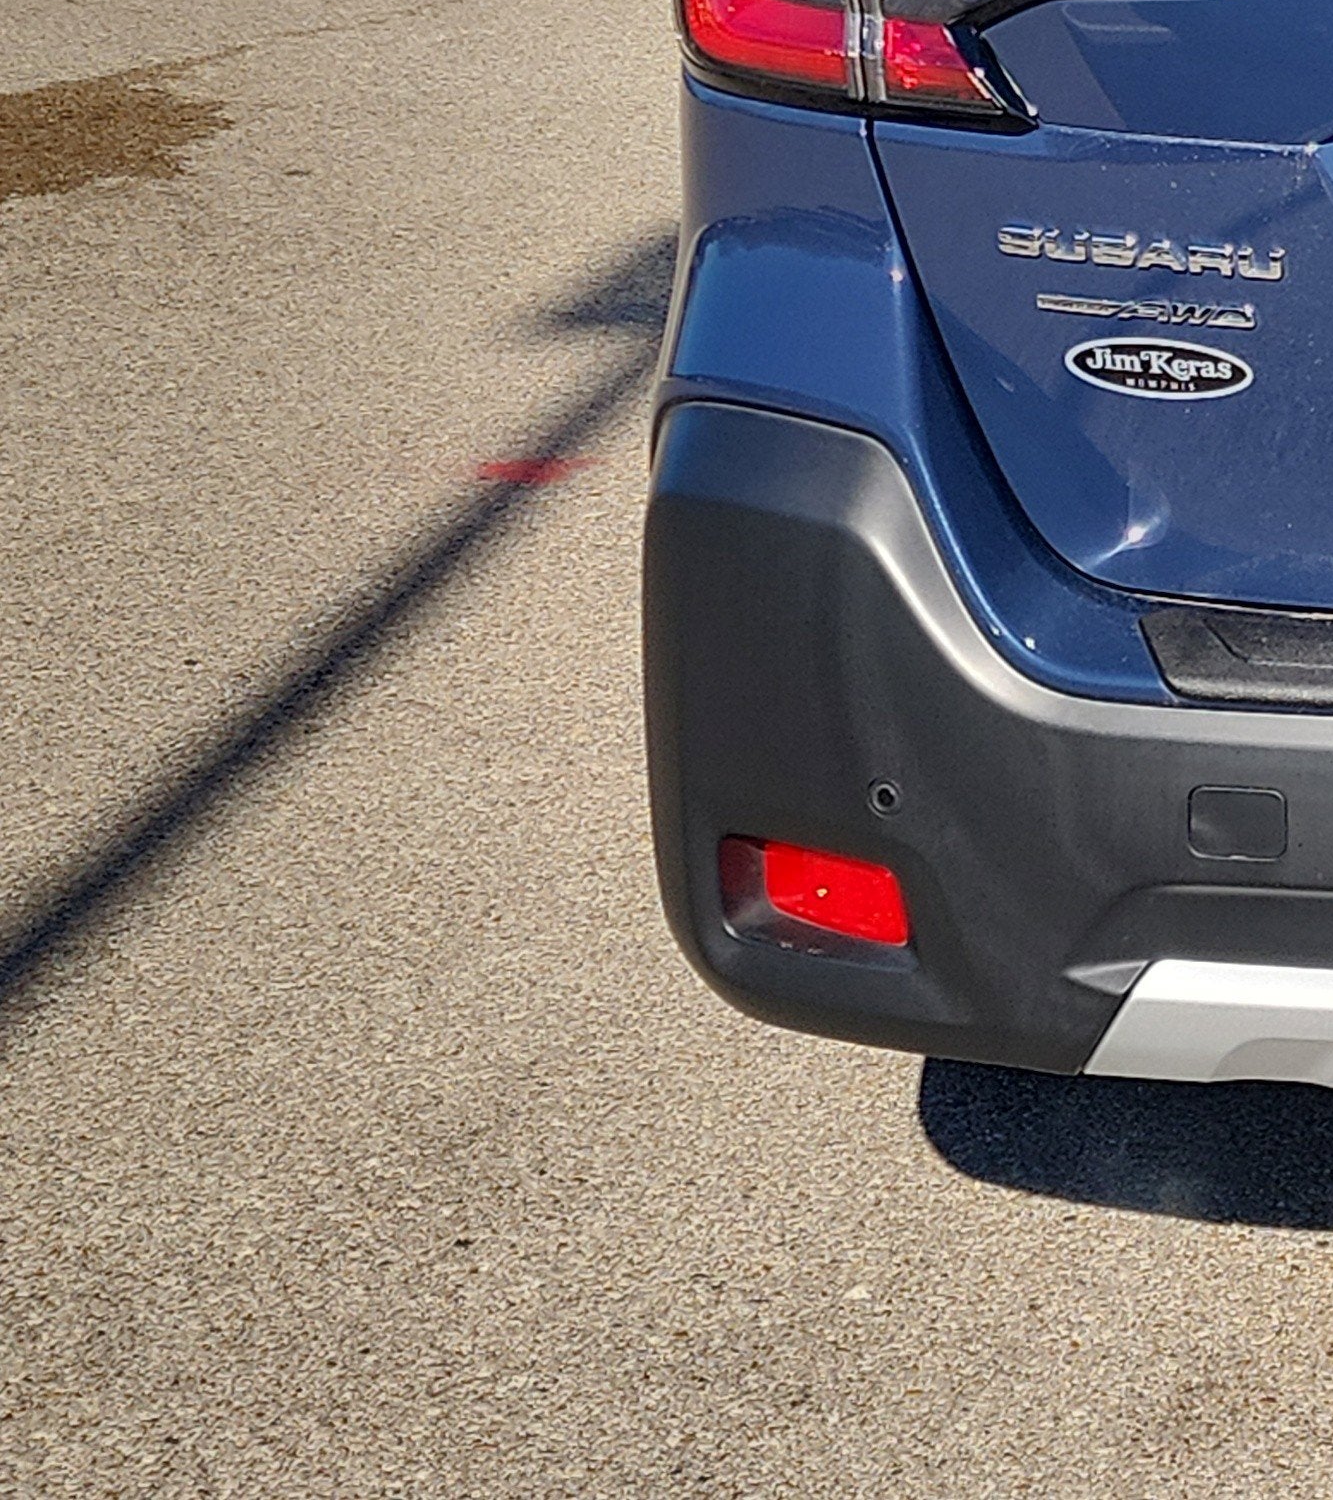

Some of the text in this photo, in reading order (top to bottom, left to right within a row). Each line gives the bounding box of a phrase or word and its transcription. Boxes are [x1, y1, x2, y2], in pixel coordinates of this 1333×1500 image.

[998, 224, 1286, 280] SUBARU
[1118, 299, 1257, 329] AWD
[1086, 348, 1233, 382] Jim Keras
